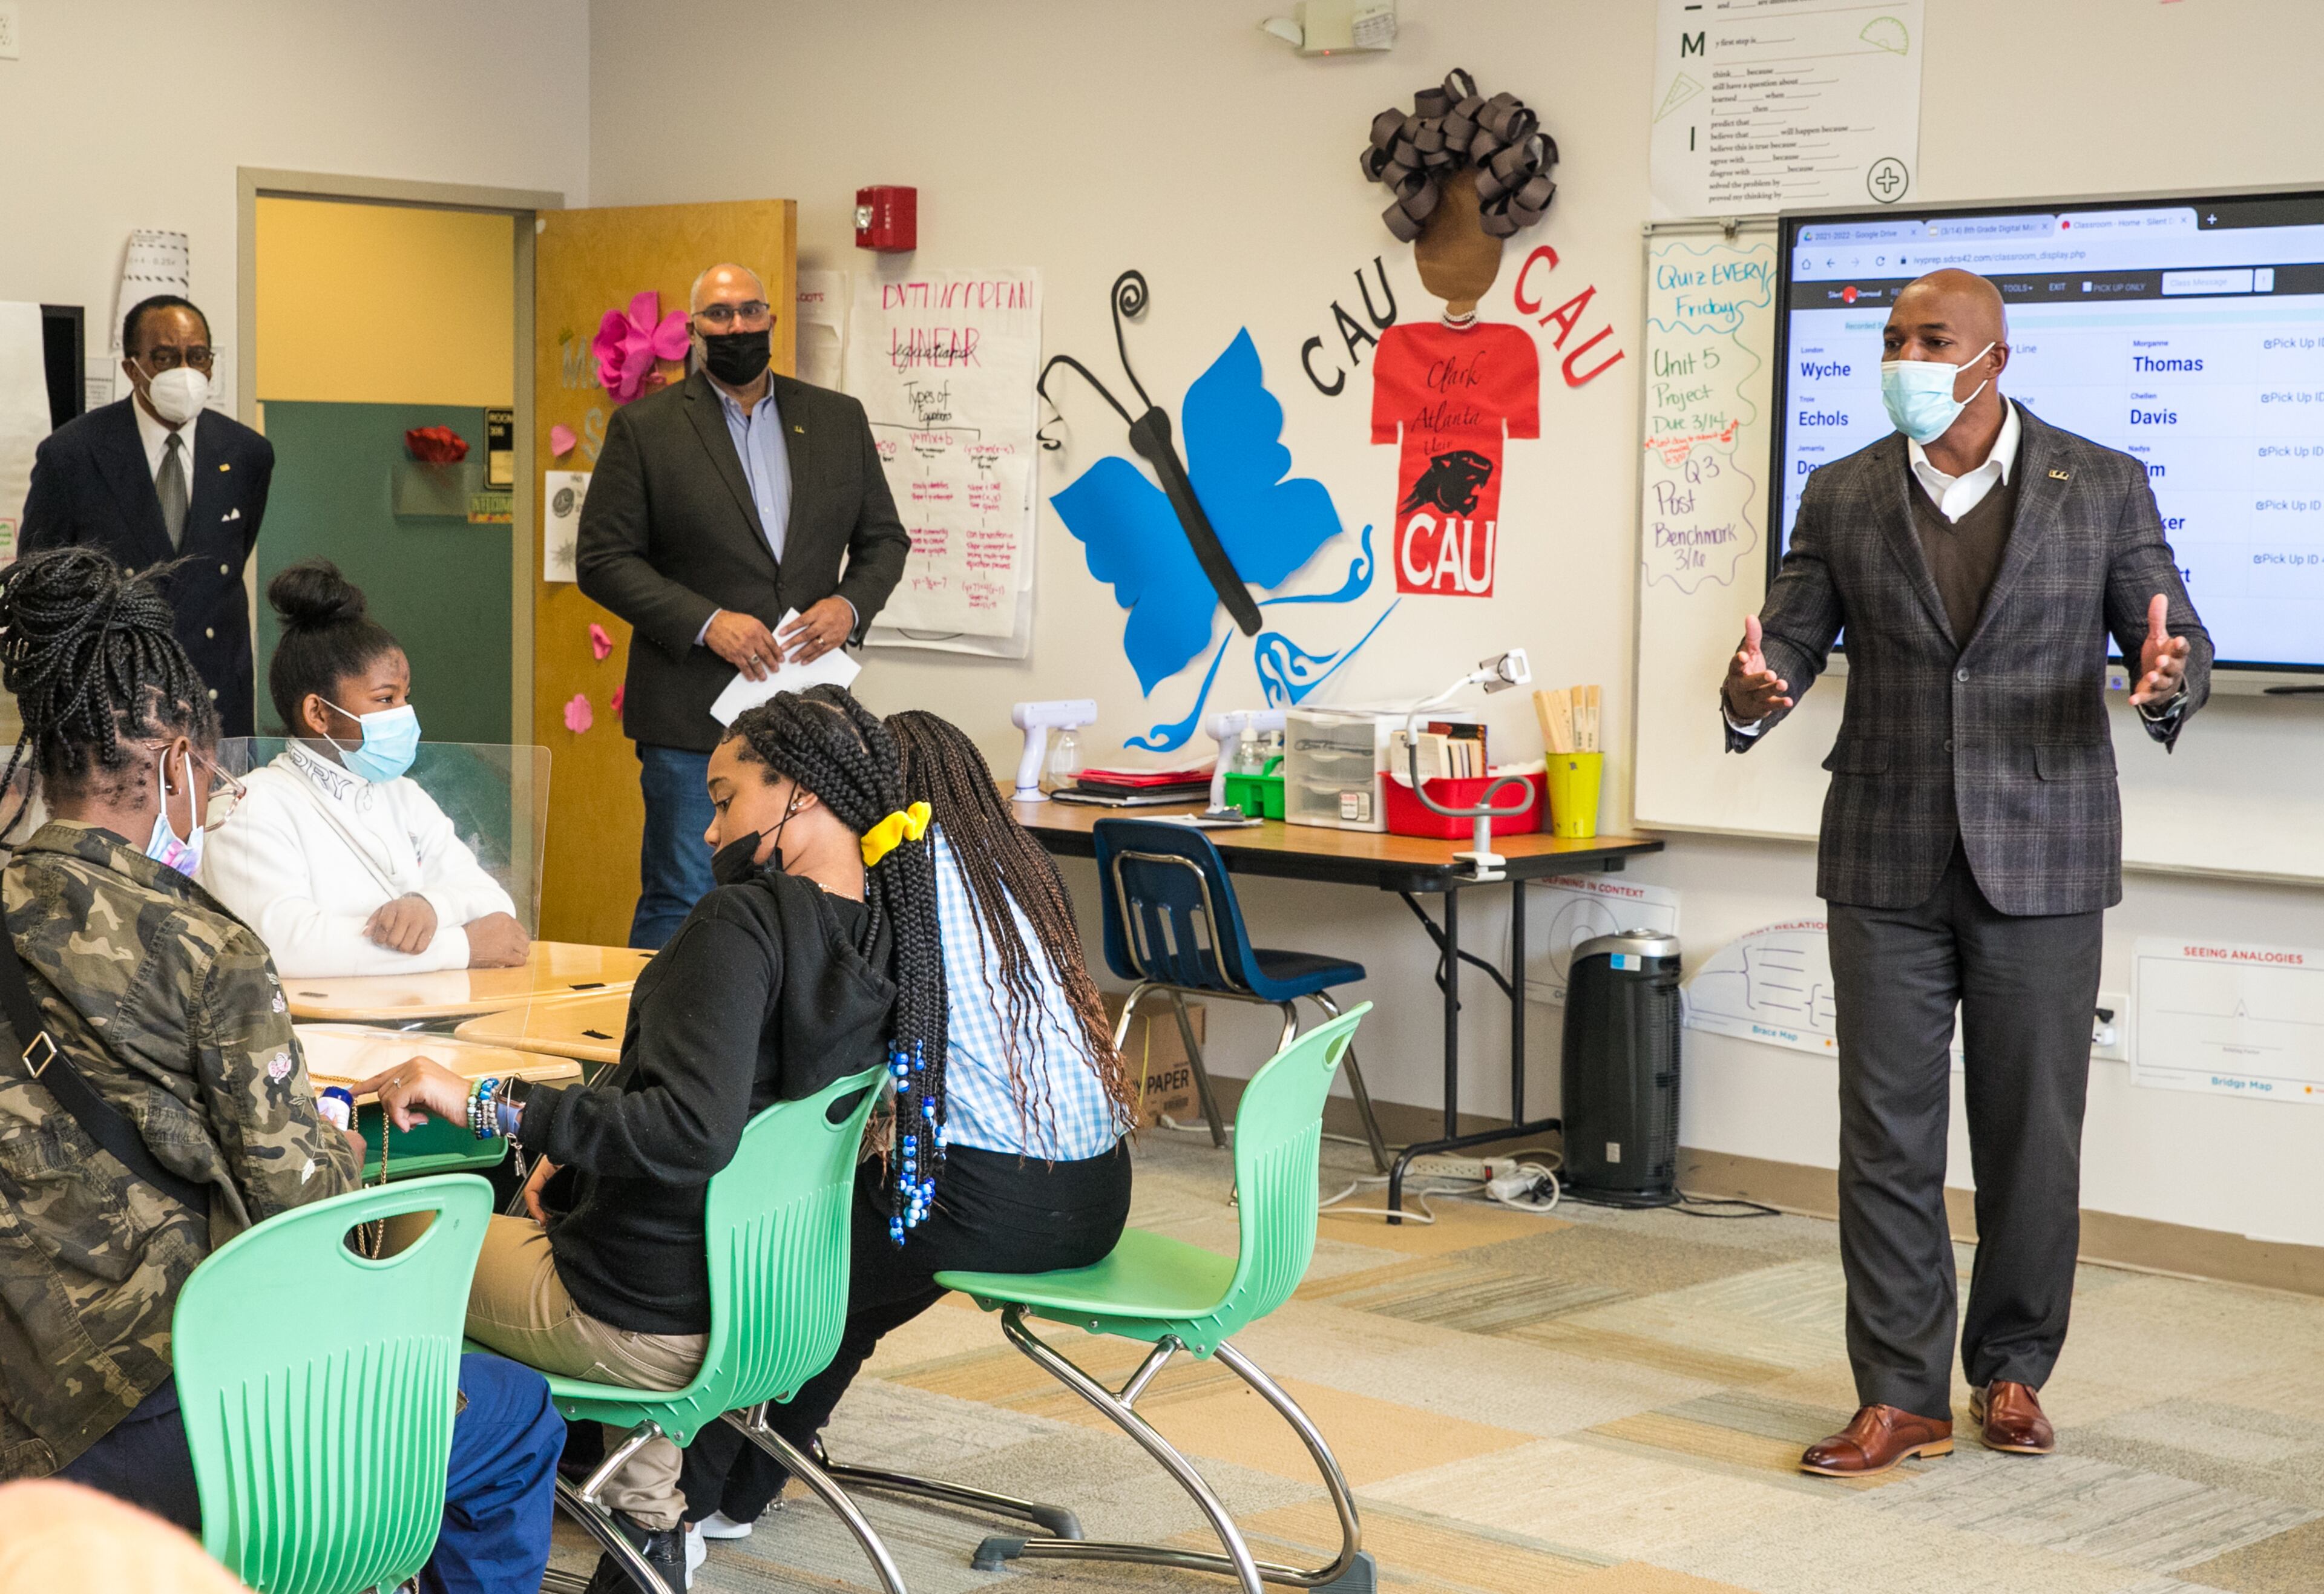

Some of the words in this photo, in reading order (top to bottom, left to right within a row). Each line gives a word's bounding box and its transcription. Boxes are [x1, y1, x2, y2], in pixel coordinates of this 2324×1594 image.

[1681, 31, 1705, 58] M
[1721, 38, 1734, 46] first
[1736, 38, 1748, 47] step
[1748, 80, 1778, 90] question
[1711, 120, 1735, 129] predict
[1711, 132, 1734, 140] believe
[1795, 127, 1820, 137] happen
[1710, 144, 1733, 153] believe
[1770, 141, 1797, 149] because
[1743, 180, 1771, 191] problem
[1744, 191, 1772, 201] thinking
[1998, 225, 2020, 234] Digital
[2073, 221, 2112, 229] Classroom
[1855, 231, 1879, 240] Google
[1712, 260, 1768, 294] EVERY
[2193, 278, 2228, 287] Message
[2049, 282, 2066, 291] EXIT
[2094, 283, 2111, 292] PICK
[2125, 282, 2146, 292] ONLY
[796, 293, 824, 303] OOTS
[1514, 244, 1626, 389] CAU
[1676, 295, 1736, 323] Friday
[1301, 255, 1397, 397] CAU
[891, 327, 982, 368] LINEAR
[2016, 344, 2037, 354] Line
[2273, 338, 2296, 349] Pick
[2300, 338, 2314, 350] Up
[1654, 348, 1696, 377] Unit
[1703, 347, 1720, 370] 5
[2133, 356, 2203, 372] Thomas
[1426, 350, 1486, 395] Clark
[1801, 361, 1851, 380] Wyche
[1652, 382, 1713, 412] Project
[2270, 392, 2293, 402] Pick
[2297, 392, 2311, 404] Up
[1411, 399, 1483, 433] Atlanta
[1692, 412, 1728, 432] 3/14
[1799, 411, 1849, 426] Echols
[2130, 409, 2178, 424] Davis
[2267, 447, 2291, 457] Pick
[2294, 447, 2309, 458] Up
[2313, 447, 2324, 457] ID
[1652, 480, 1696, 516] Post
[2265, 500, 2288, 511] Pick
[2291, 500, 2306, 512] Up
[2310, 500, 2322, 511] ID
[1652, 522, 1738, 548] Benchmark
[1401, 513, 1496, 594] CAU
[2262, 554, 2286, 564] Pick
[2289, 554, 2304, 565] Up
[2308, 554, 2319, 565] ID
[285, 739, 353, 801] DRY
[1598, 883, 1645, 898] CONTEXT
[2184, 946, 2227, 959] SEEING
[2231, 950, 2303, 965] ANALOGIES
[1753, 1025, 1776, 1037] Brace
[1780, 1028, 1798, 1041] Map
[1146, 1069, 1189, 1095] PAPER
[2211, 1076, 2246, 1090] Bridge
[2249, 1080, 2273, 1092] Map
